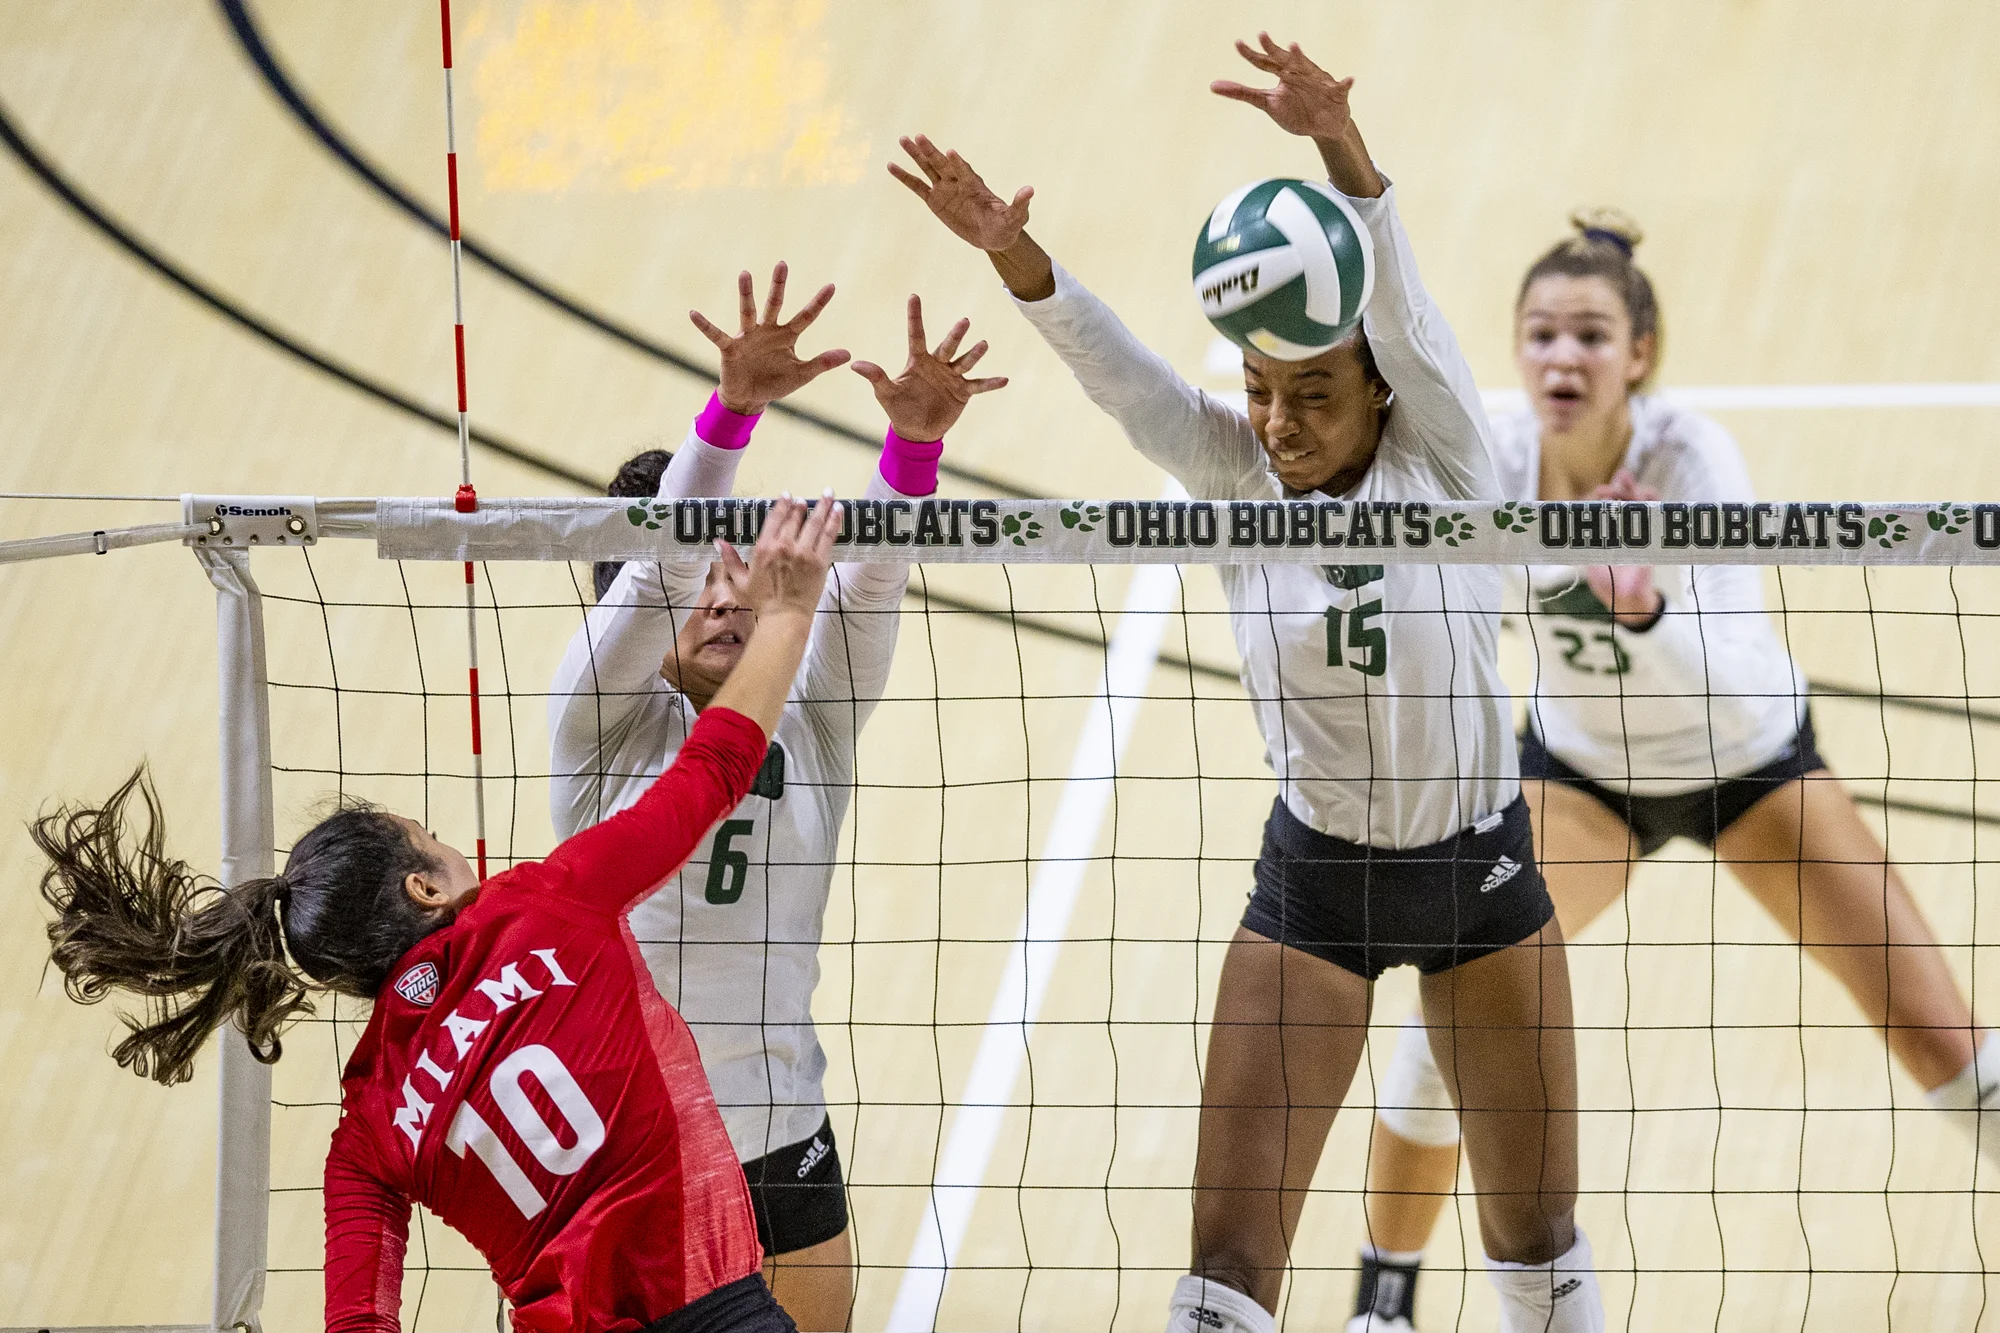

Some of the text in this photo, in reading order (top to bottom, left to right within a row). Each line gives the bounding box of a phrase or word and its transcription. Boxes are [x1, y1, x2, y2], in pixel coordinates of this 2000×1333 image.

[228, 505, 292, 517] Senoh
[1106, 501, 1431, 548] OHIO BOBCATS
[1539, 502, 1865, 549] OHIO BOBCATS
[1323, 598, 1387, 677] 15
[705, 819, 755, 905] 6
[402, 971, 436, 999] MAC
[393, 948, 577, 1156] MIAMI
[445, 1044, 606, 1221] 10
[1189, 1310, 1223, 1329] adidas
